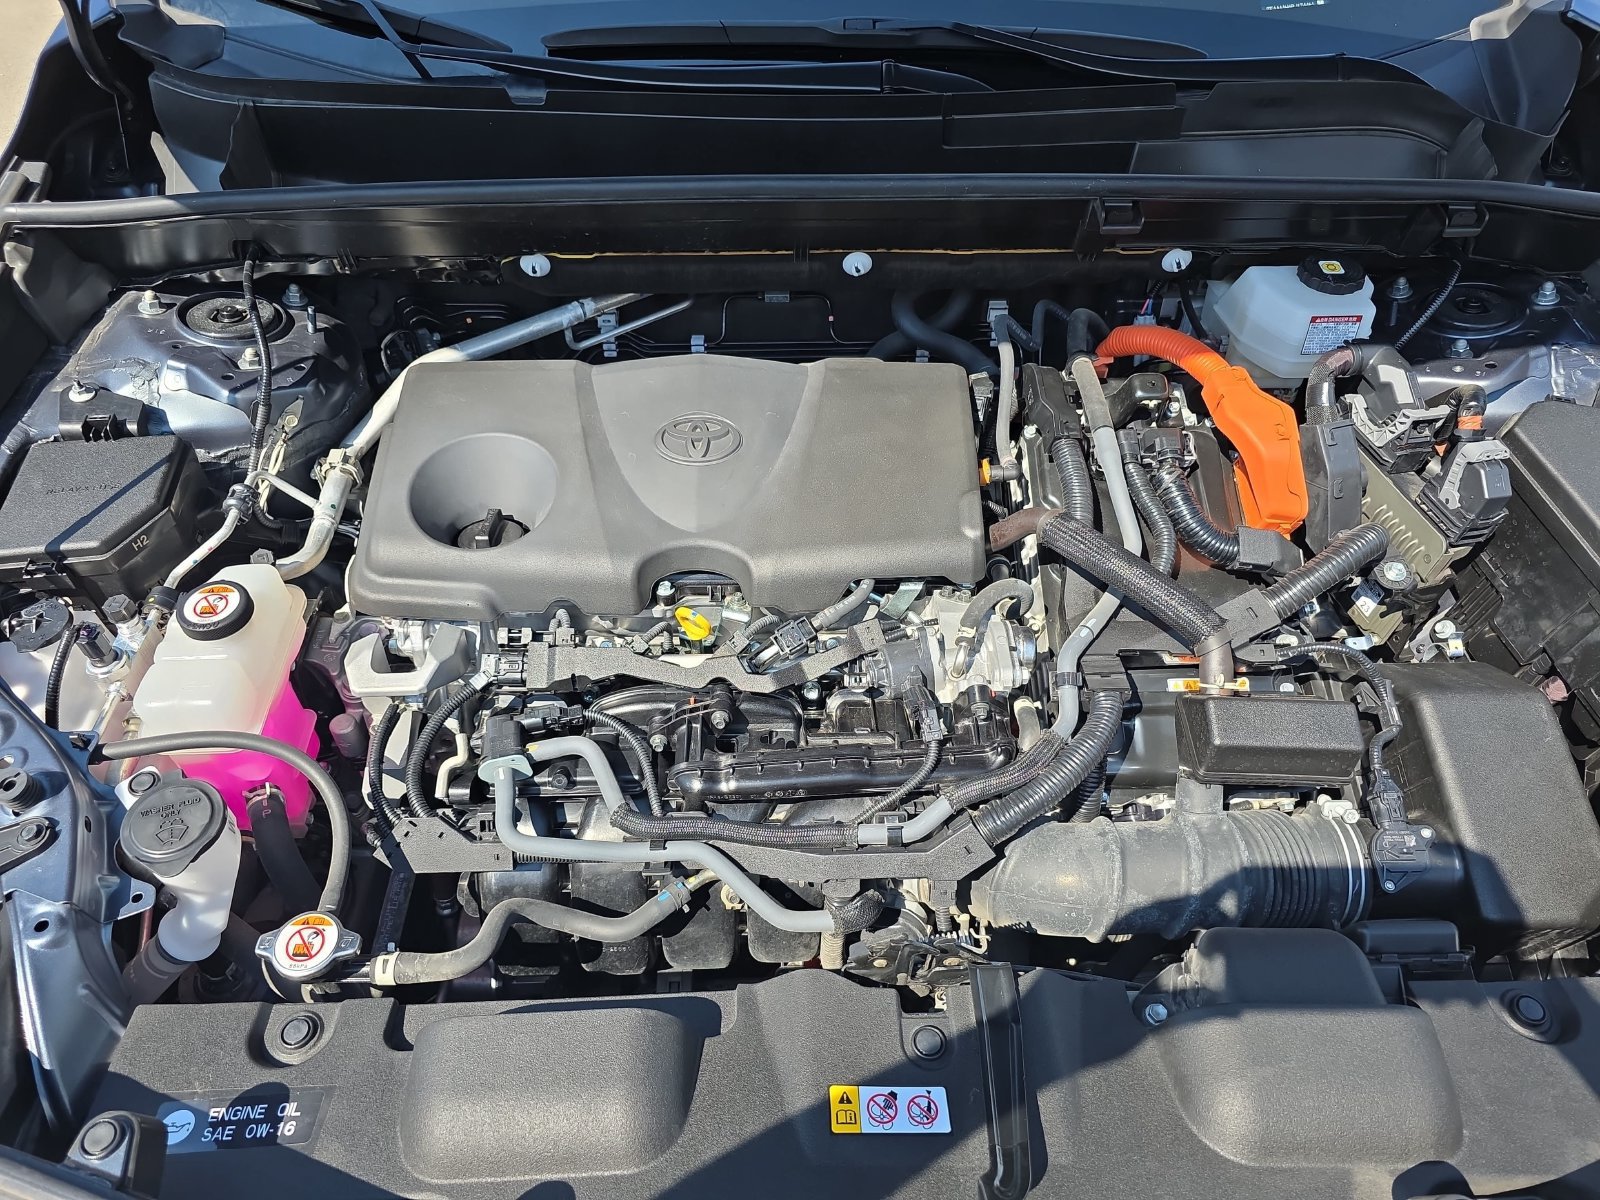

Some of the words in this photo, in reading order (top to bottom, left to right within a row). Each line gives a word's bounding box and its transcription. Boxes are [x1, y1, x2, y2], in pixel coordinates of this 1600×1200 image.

[131, 534, 150, 551] H2
[1360, 601, 1371, 613] 23
[140, 804, 175, 817] WASHER
[179, 797, 201, 807] FLUID
[161, 809, 181, 818] ONLY
[207, 1104, 268, 1122] ENGINE
[277, 1101, 301, 1117] OIL
[201, 1125, 236, 1142] SAE
[245, 1120, 297, 1139] 0W-16
